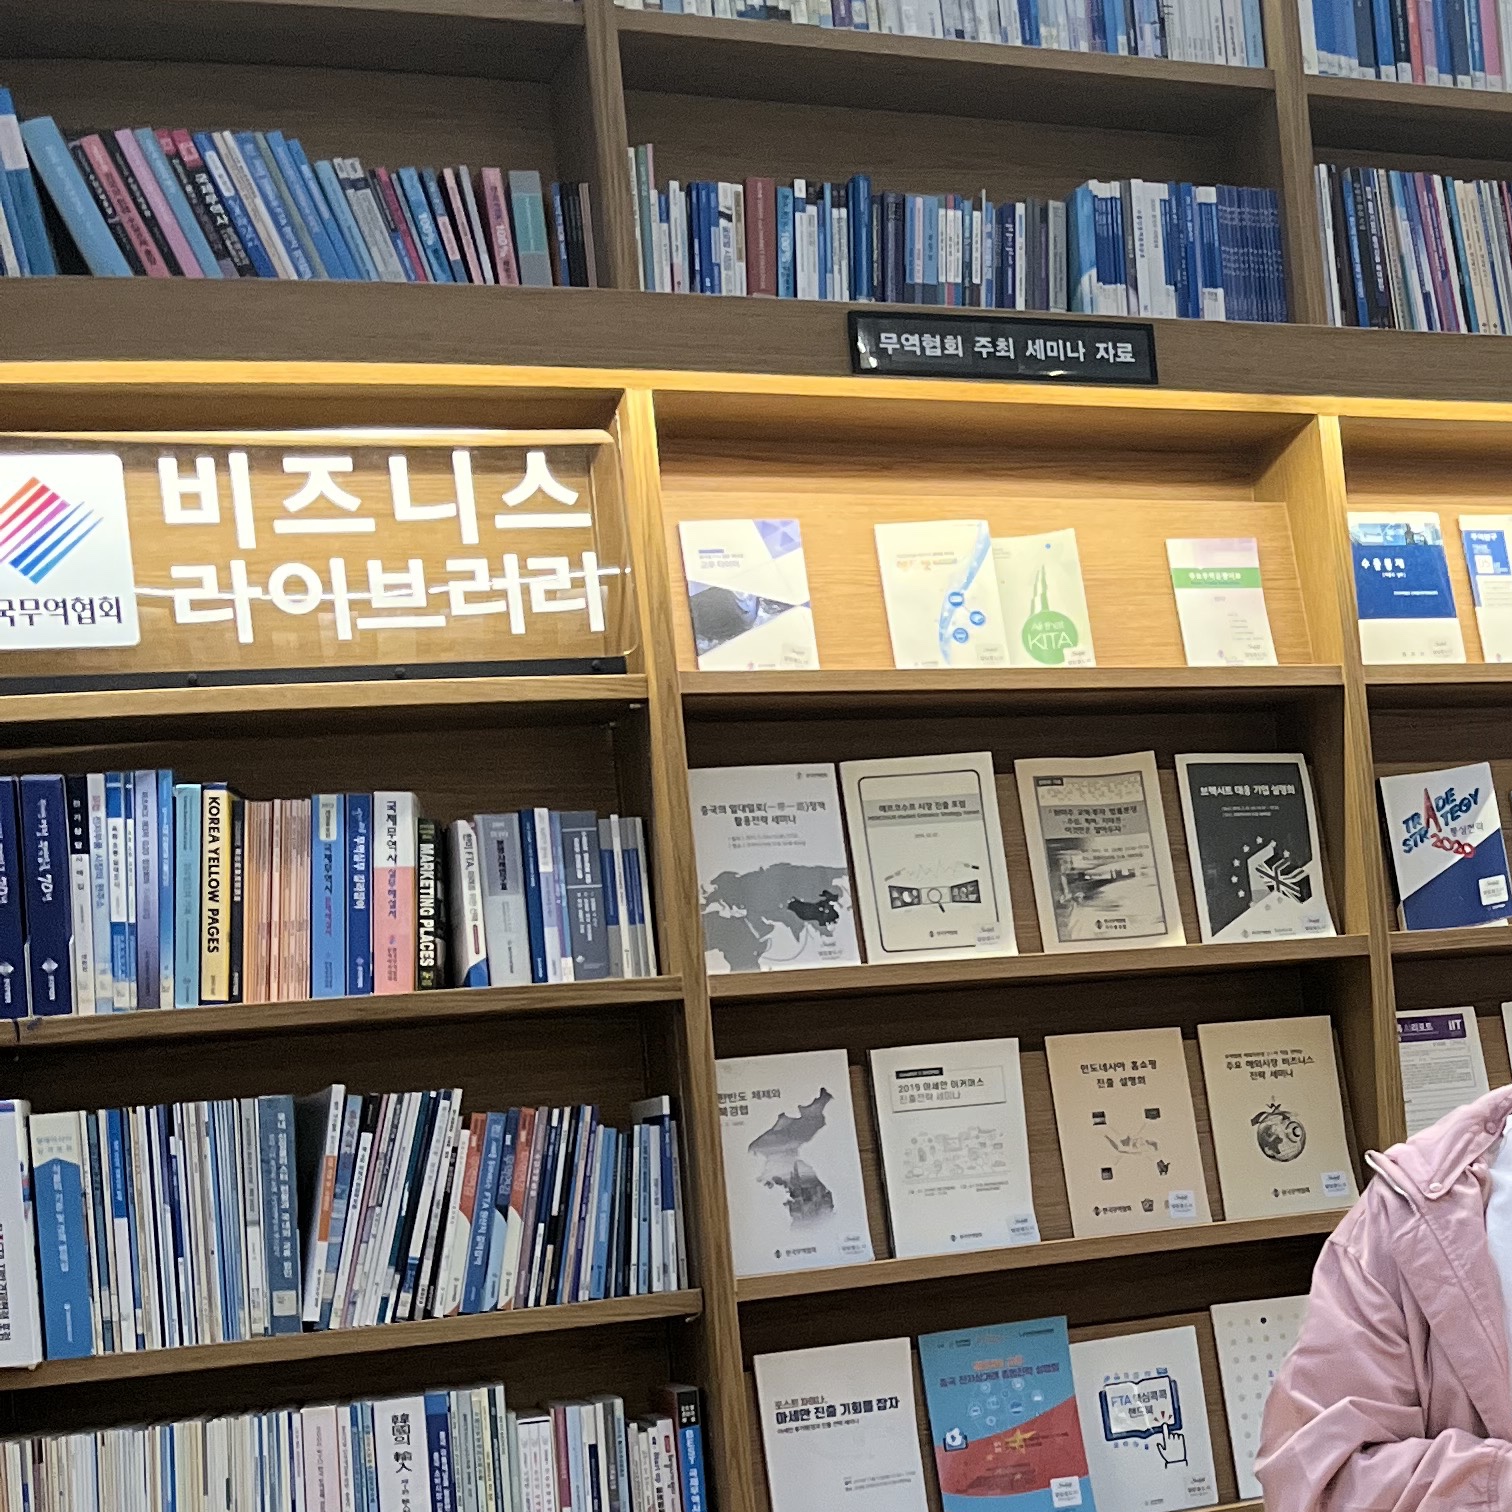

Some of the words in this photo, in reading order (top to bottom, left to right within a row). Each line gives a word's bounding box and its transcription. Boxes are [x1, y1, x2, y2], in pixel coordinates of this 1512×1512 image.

[879, 332, 964, 358] 무역협회
[973, 336, 1016, 361] 주최
[1025, 339, 1086, 363] 세미나
[1095, 341, 1136, 364] 자료
[157, 450, 592, 550] 비즈니스
[0, 594, 123, 628] 국무역협회
[170, 551, 607, 644] 라이브러리
[1027, 631, 1074, 651] KITA
[1200, 785, 1234, 797] 브렉시트
[207, 795, 221, 844] KOREA
[1430, 832, 1477, 859] 2020
[207, 845, 221, 904] YELLOW
[419, 843, 435, 916] MARKETING
[206, 907, 220, 955] PAGES
[419, 918, 435, 967] PLACES
[1080, 1061, 1126, 1075] 인도네시아
[897, 1082, 921, 1094] 2019
[718, 1104, 749, 1118] 북경협
[776, 1407, 812, 1425] 아세안
[813, 1404, 837, 1420] 진출
[839, 1399, 874, 1416] 기회를
[876, 1396, 901, 1411] 잡자
[1110, 1394, 1133, 1408] FTA
